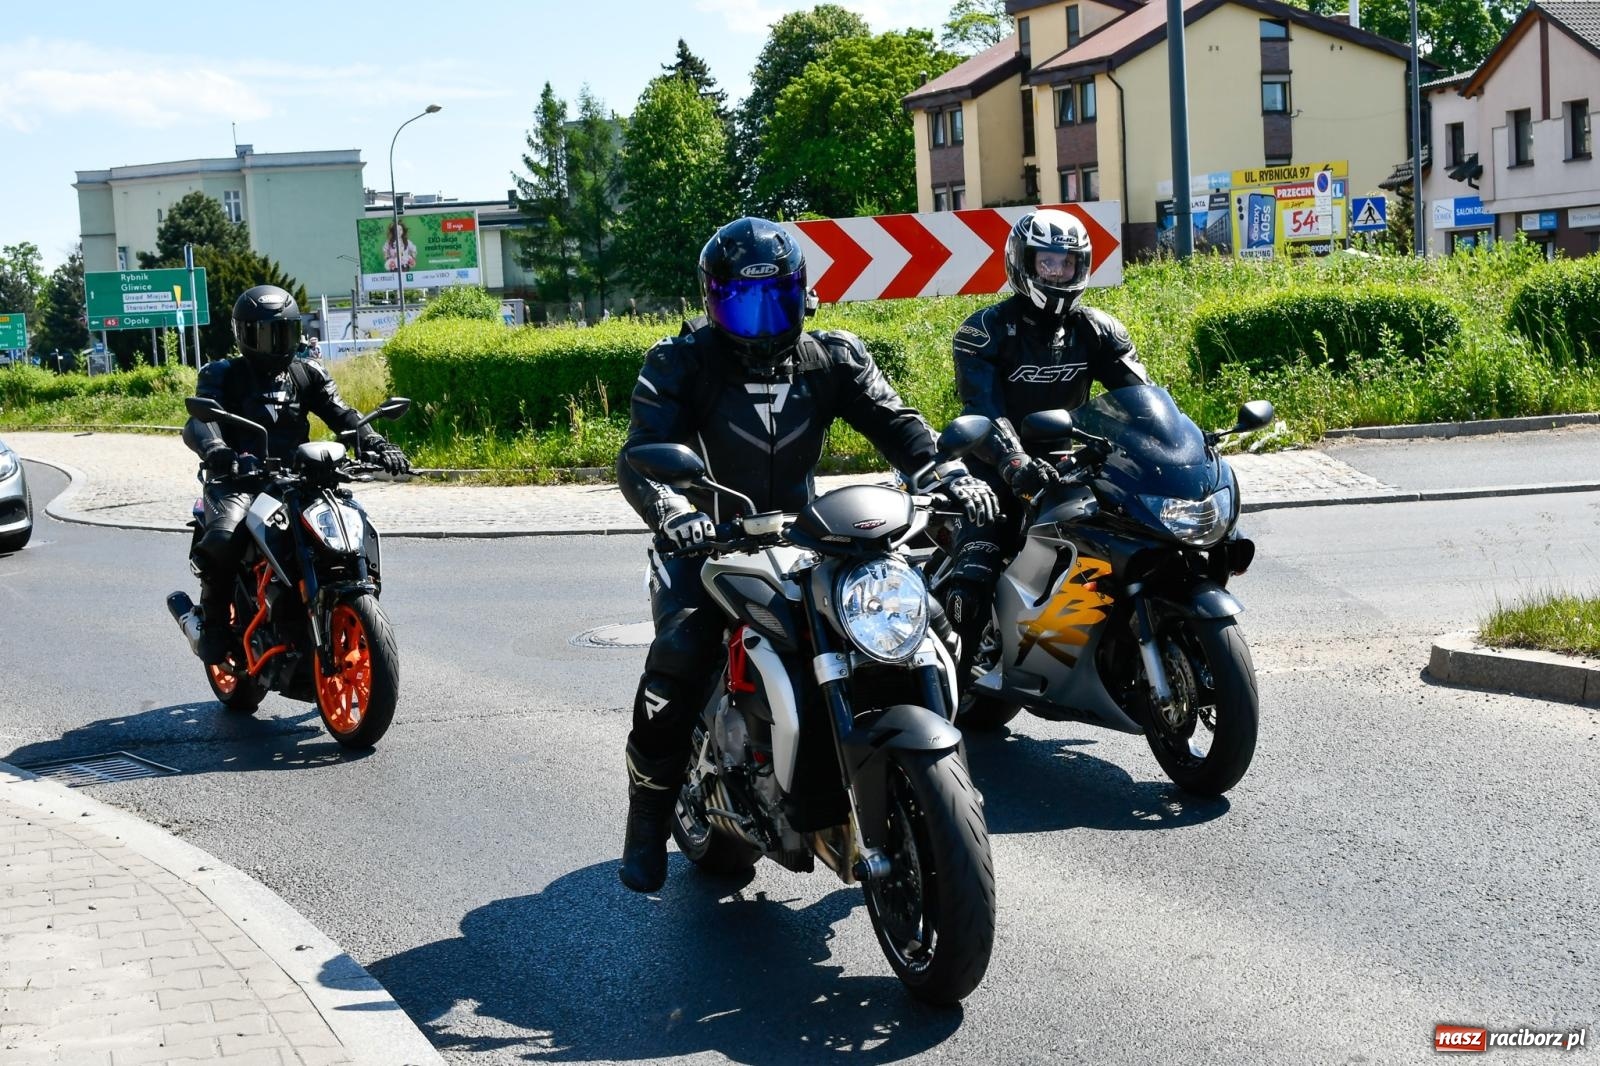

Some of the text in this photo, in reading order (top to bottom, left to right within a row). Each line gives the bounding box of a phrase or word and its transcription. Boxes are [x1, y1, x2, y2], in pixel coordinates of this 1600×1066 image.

[1245, 171, 1257, 183] UL.
[1259, 168, 1298, 181] RYBNICKA
[1300, 166, 1310, 178] 97
[1276, 186, 1315, 198] PRZECENY
[1455, 207, 1473, 216] SALON
[1252, 204, 1262, 241] Galaxy
[745, 264, 775, 275] HJC
[120, 273, 149, 282] Rybnik
[120, 284, 152, 292] Gliwice
[123, 317, 150, 326] Opole
[1008, 362, 1088, 383] RST
